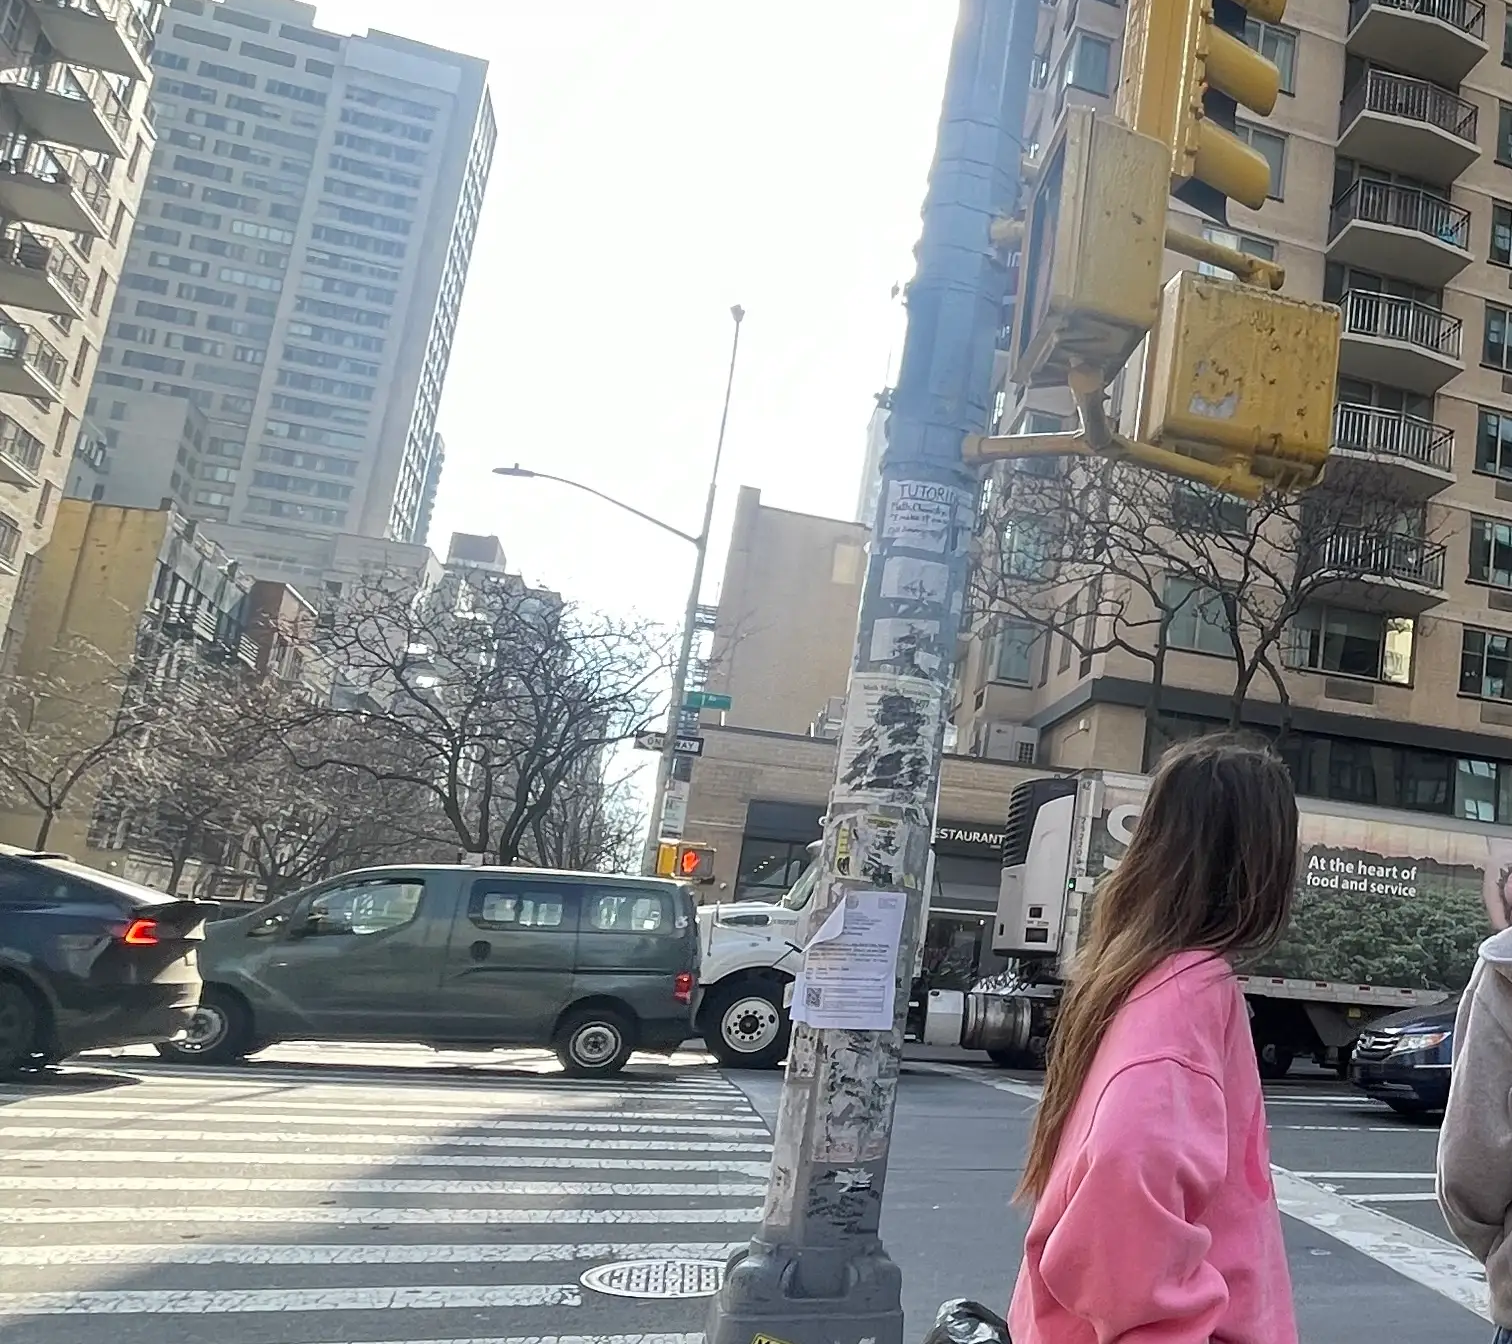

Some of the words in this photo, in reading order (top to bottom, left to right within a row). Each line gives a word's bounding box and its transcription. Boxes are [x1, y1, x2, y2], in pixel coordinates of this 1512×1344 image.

[647, 736, 662, 746] ON
[677, 740, 695, 750] AY
[935, 827, 1006, 845] ESTAURANT
[1308, 855, 1326, 871] At
[1329, 857, 1355, 874] the
[1357, 860, 1398, 879] heart
[1400, 866, 1417, 881] of
[1306, 872, 1339, 889] food
[1341, 878, 1368, 892] and
[1369, 882, 1417, 897] service
